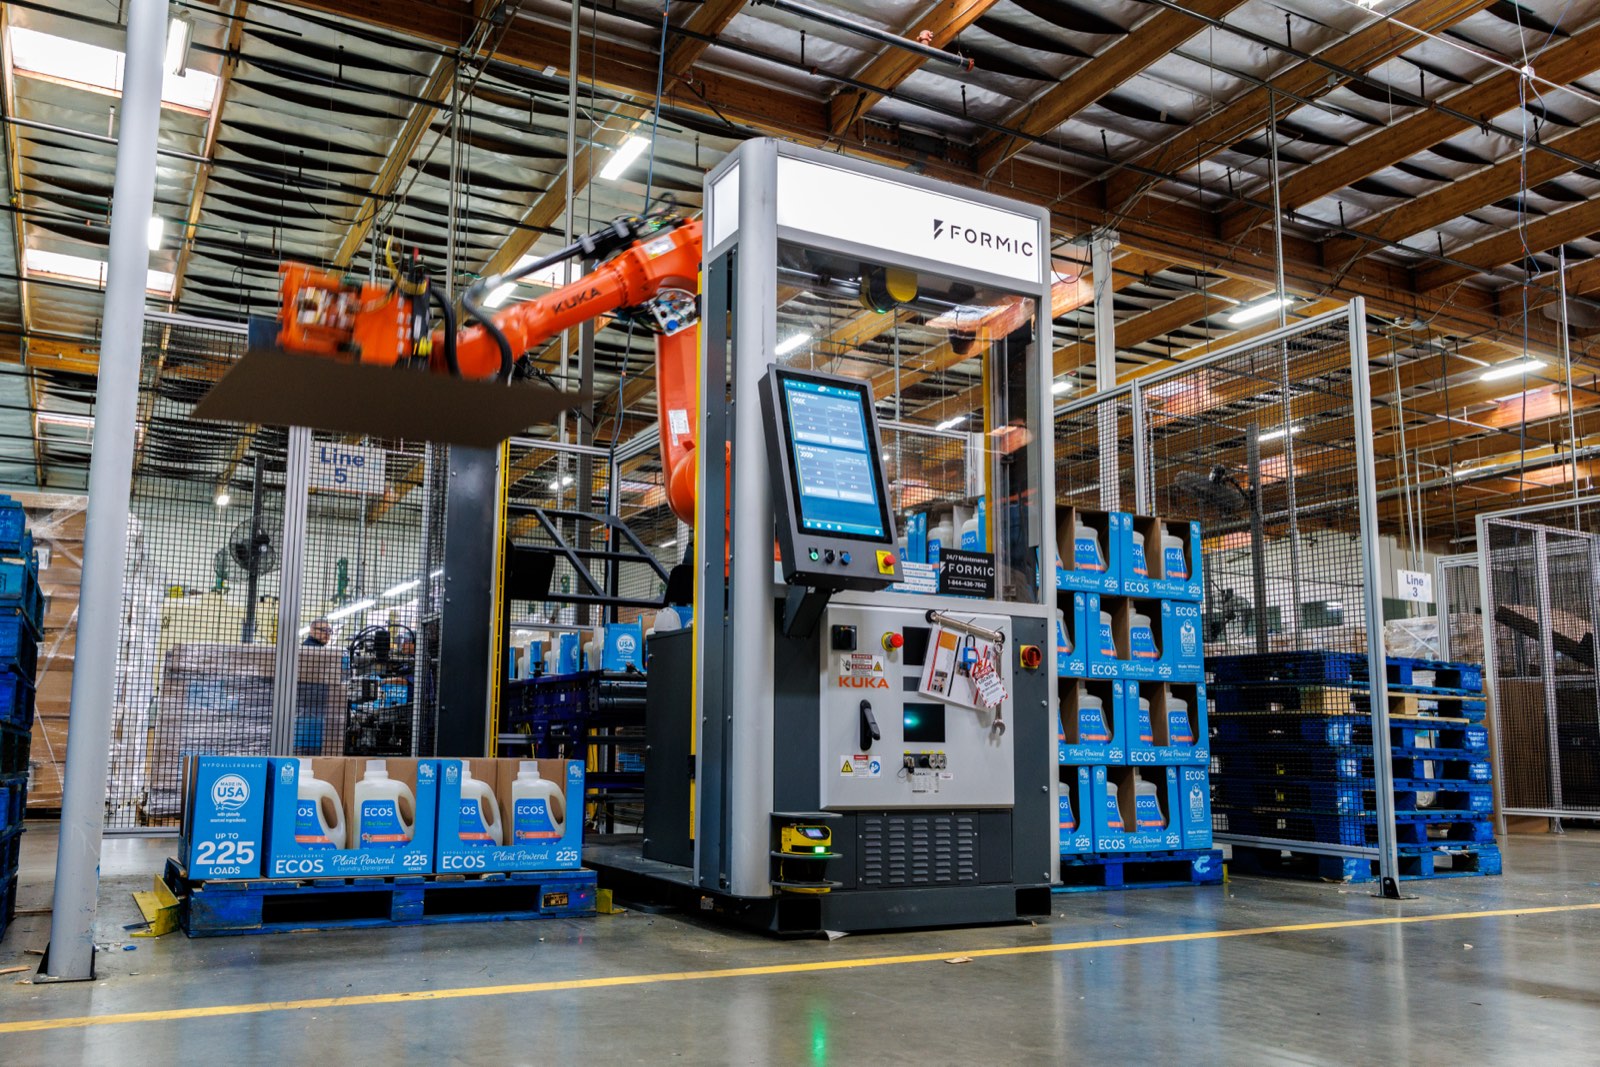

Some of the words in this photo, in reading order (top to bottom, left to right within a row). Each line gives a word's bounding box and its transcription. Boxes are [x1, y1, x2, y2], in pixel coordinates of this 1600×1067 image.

[950, 224, 1033, 257] FORMIC
[551, 287, 601, 314] KUKA
[321, 447, 365, 467] Line
[335, 468, 347, 484] 5
[958, 555, 989, 564] Maintenance
[948, 563, 994, 577] FORMIC
[1104, 580, 1118, 589] 225
[1406, 574, 1424, 586] Line
[1124, 581, 1149, 593] ECOS
[1188, 585, 1201, 594] 225
[1412, 586, 1418, 597] 3
[1175, 606, 1198, 617] ECOS
[1070, 662, 1084, 671] 225
[1091, 664, 1118, 676] ECOS
[1158, 666, 1172, 675] 225
[839, 676, 889, 689] KUKA
[1080, 714, 1101, 722] ECOS
[1109, 750, 1123, 759] 225
[1131, 751, 1156, 762] ECOS
[1195, 750, 1208, 759] 225
[1185, 770, 1205, 781] ECOS
[217, 787, 245, 797] USA
[298, 808, 314, 817] OS
[364, 808, 393, 817] ECOS
[517, 806, 545, 815] ECOS
[1075, 838, 1090, 847] 225
[1098, 839, 1126, 850] ECOS
[1166, 835, 1180, 844] 225
[196, 841, 255, 865] 225
[492, 851, 516, 862] Plant
[517, 850, 549, 861] Powered
[555, 851, 578, 861] 225
[332, 854, 358, 866] Plant
[359, 854, 395, 866] Powered
[403, 855, 428, 866] 225
[442, 855, 486, 869] ECOS
[209, 866, 240, 875] LOADS
[275, 859, 324, 874] ECOS
